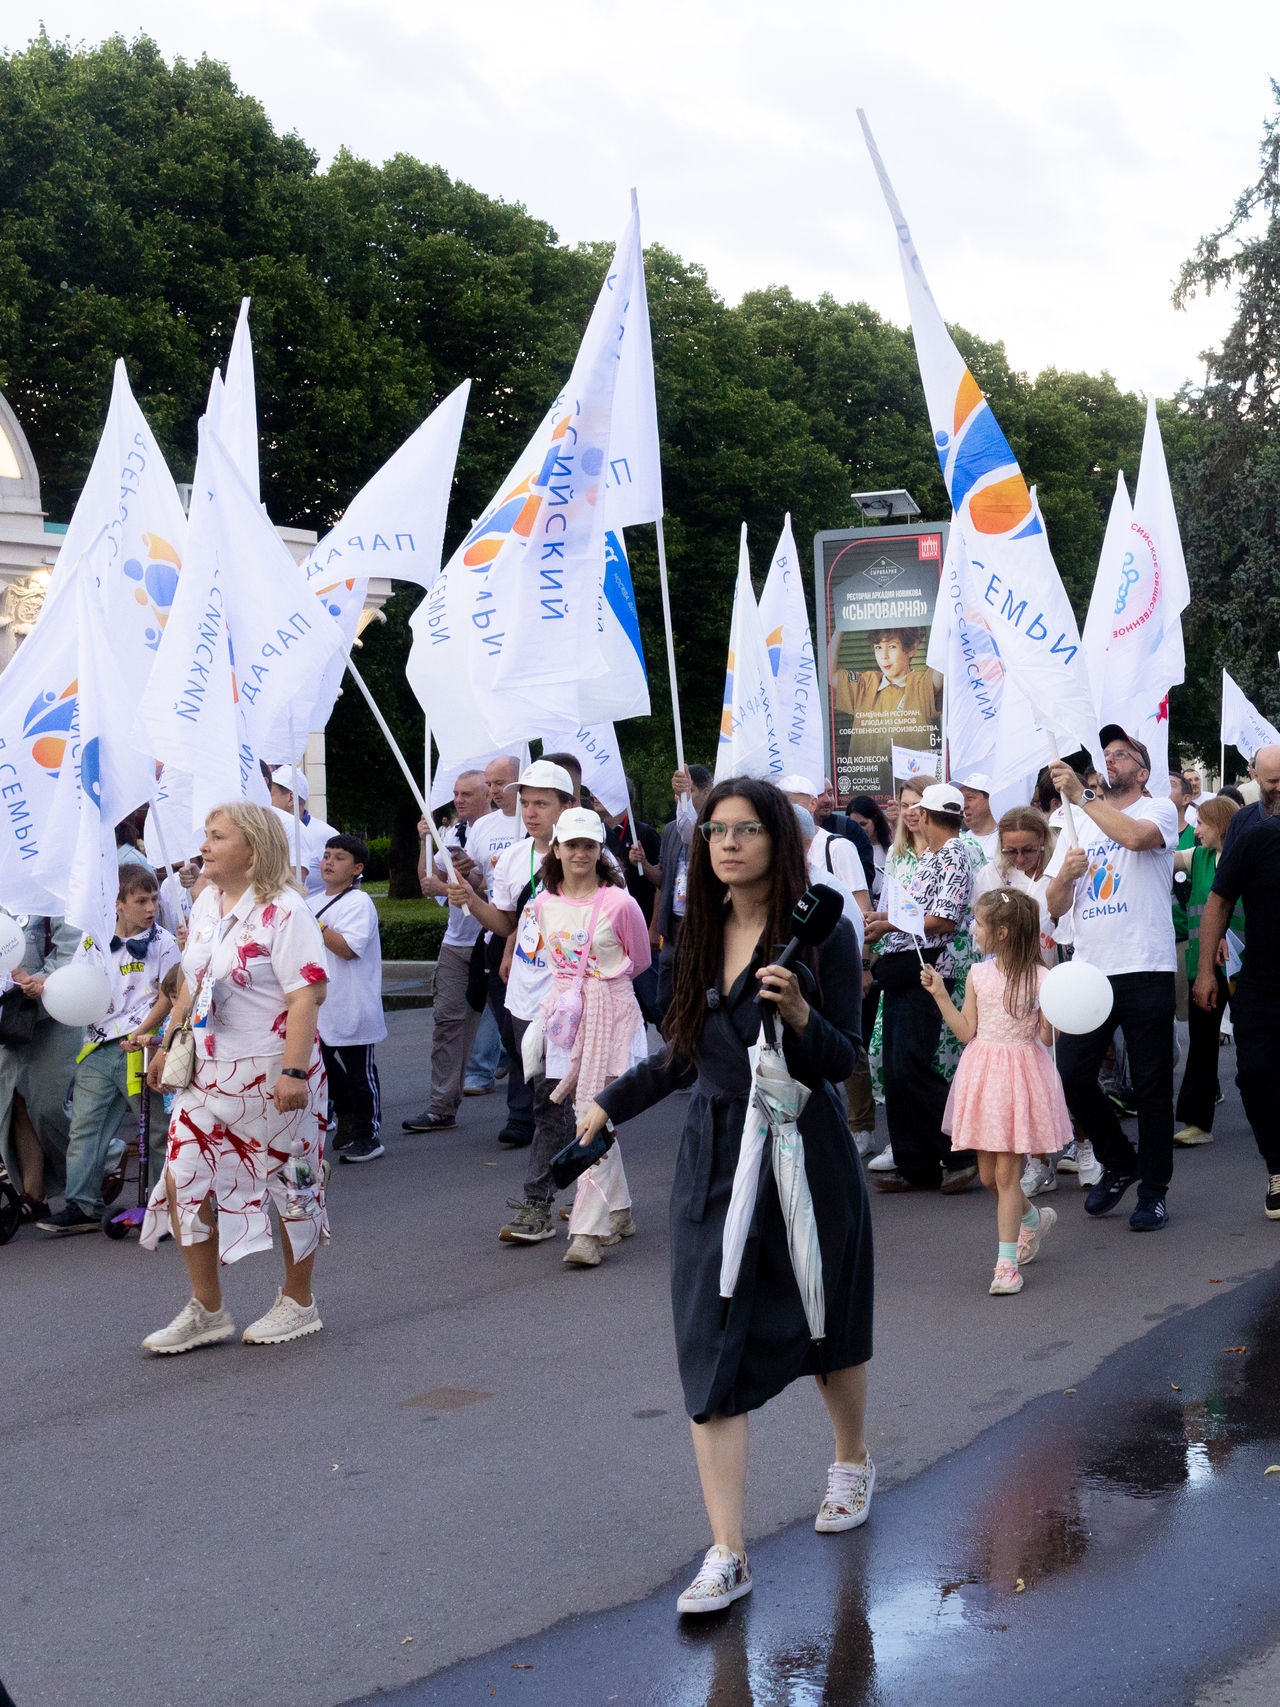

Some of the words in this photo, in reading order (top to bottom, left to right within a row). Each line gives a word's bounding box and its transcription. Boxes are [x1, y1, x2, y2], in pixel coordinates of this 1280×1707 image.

[846, 592, 872, 601] РЕСТОРАН
[871, 591, 896, 600] АРКАДИЯ
[895, 588, 922, 598] НОВИКОВА
[842, 600, 928, 621] «СЫРОВАРНЯ»
[971, 559, 1078, 665] ЕМЬИ
[839, 727, 887, 735] СОБСТВЕННОГО
[929, 733, 942, 747] 6+
[837, 757, 853, 765] ПОД
[854, 755, 889, 764] КОЛЕСОМ
[837, 765, 879, 773] ОБОЗРЕНИЯ
[852, 777, 880, 785] СОЛНЦЕ
[489, 842, 512, 851] ПАР
[1082, 902, 1128, 920] СЕМЬИ
